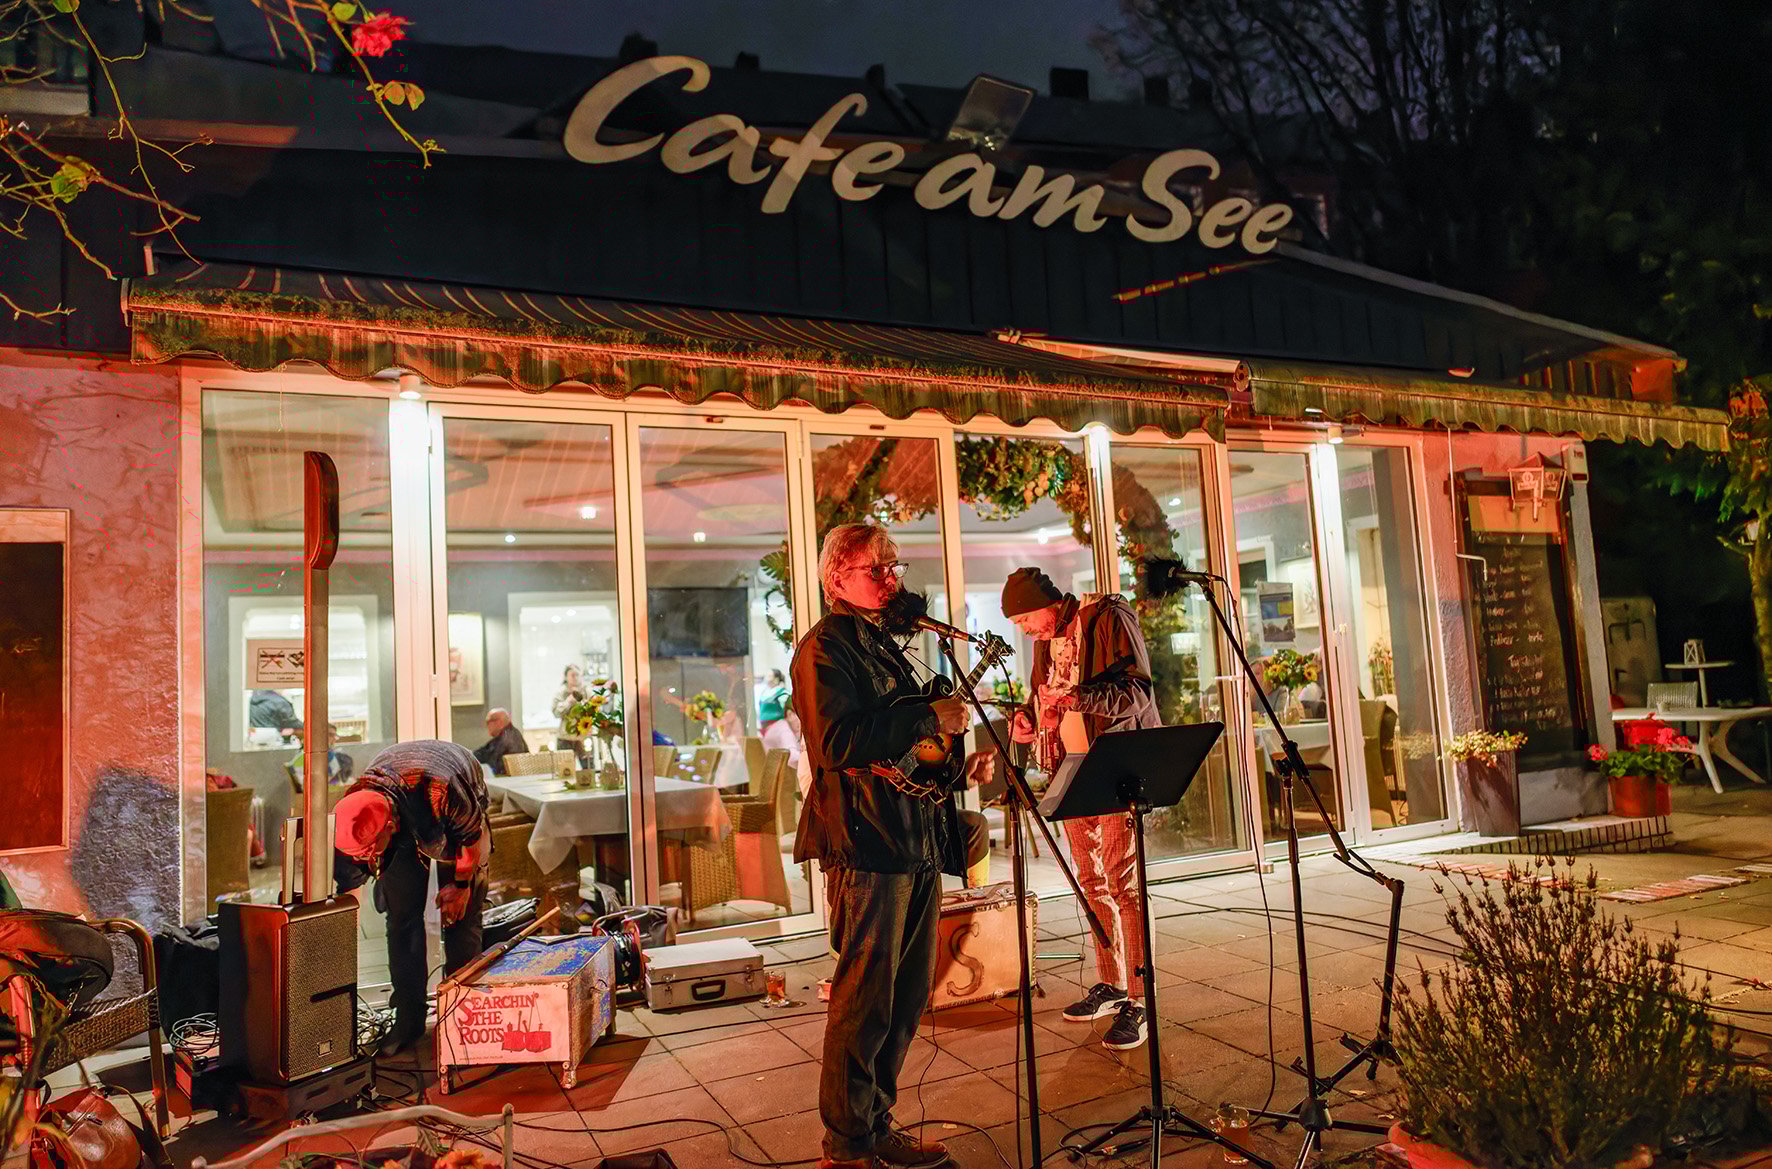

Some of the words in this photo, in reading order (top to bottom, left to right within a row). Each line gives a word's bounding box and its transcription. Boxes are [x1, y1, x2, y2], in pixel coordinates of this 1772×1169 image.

[563, 55, 905, 213] Cafe
[914, 152, 1107, 233] am
[1125, 148, 1294, 254] See
[470, 1011, 502, 1026] THE
[458, 1026, 505, 1045] ROOTS
